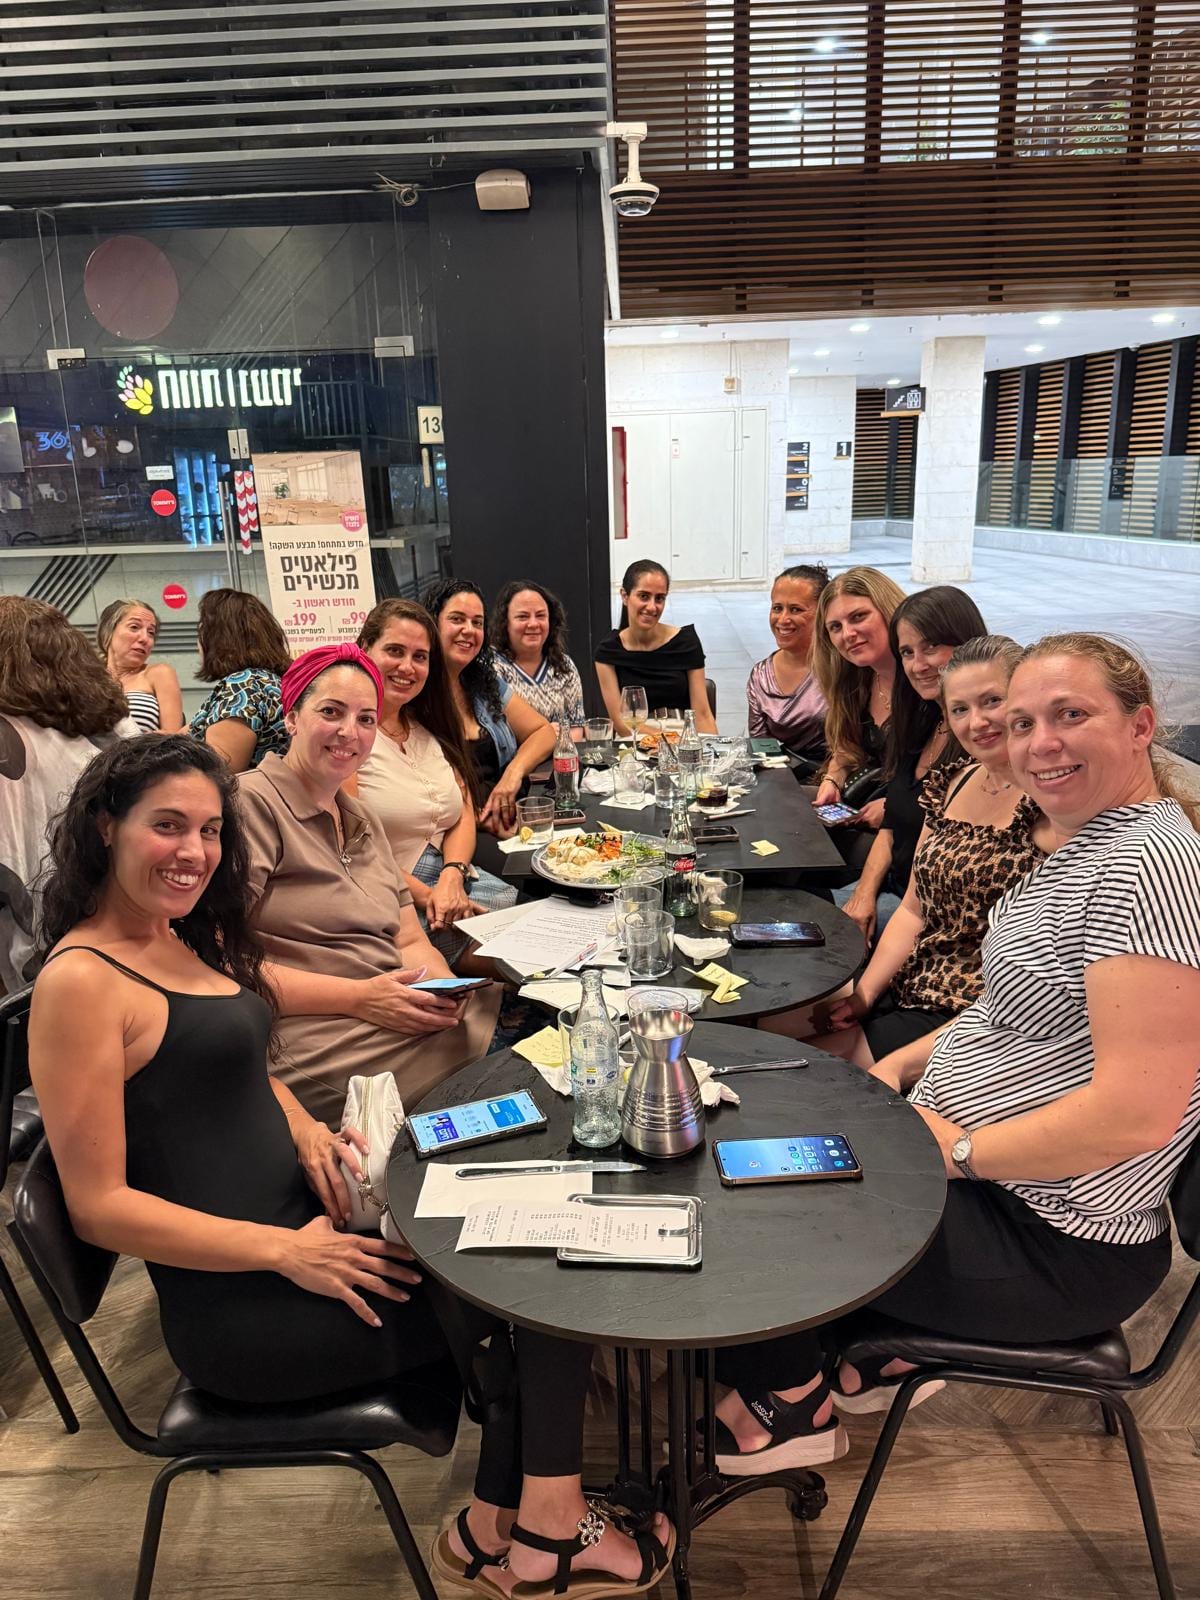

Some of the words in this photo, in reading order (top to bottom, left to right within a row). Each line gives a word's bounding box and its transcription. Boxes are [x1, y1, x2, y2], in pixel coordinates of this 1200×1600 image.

[840, 442, 847, 455] 1
[269, 541, 295, 551] השקה!
[296, 541, 316, 549] מבצע
[318, 540, 346, 549] במתחם!
[347, 540, 364, 548] חדש
[280, 552, 357, 573] פילאטיס
[283, 573, 359, 591] מכשירים
[303, 598, 331, 609] ראשון
[332, 598, 356, 607] חודש
